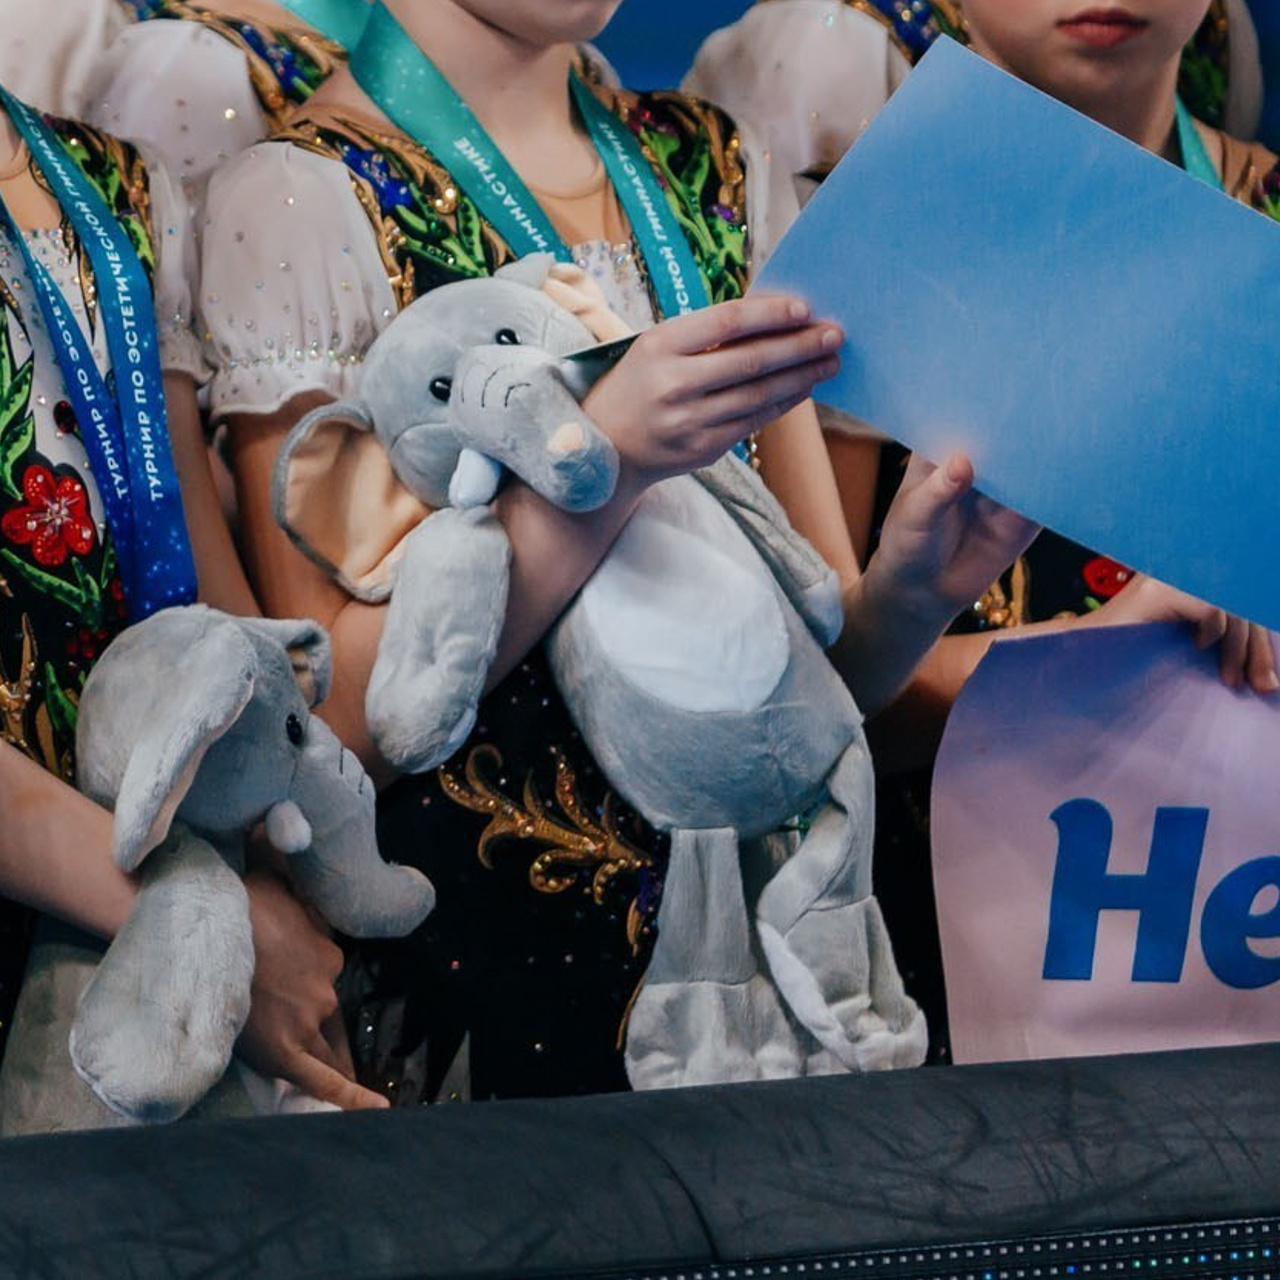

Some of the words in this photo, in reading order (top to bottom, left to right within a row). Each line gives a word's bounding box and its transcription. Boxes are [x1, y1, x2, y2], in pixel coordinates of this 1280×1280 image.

[75, 201, 141, 365] ЭСТЕТИЧЕСКОЙ
[76, 368, 96, 402] ПО
[131, 370, 147, 404] ПО
[91, 408, 129, 499] ТУРНИР
[137, 410, 164, 502] ТУРНИР
